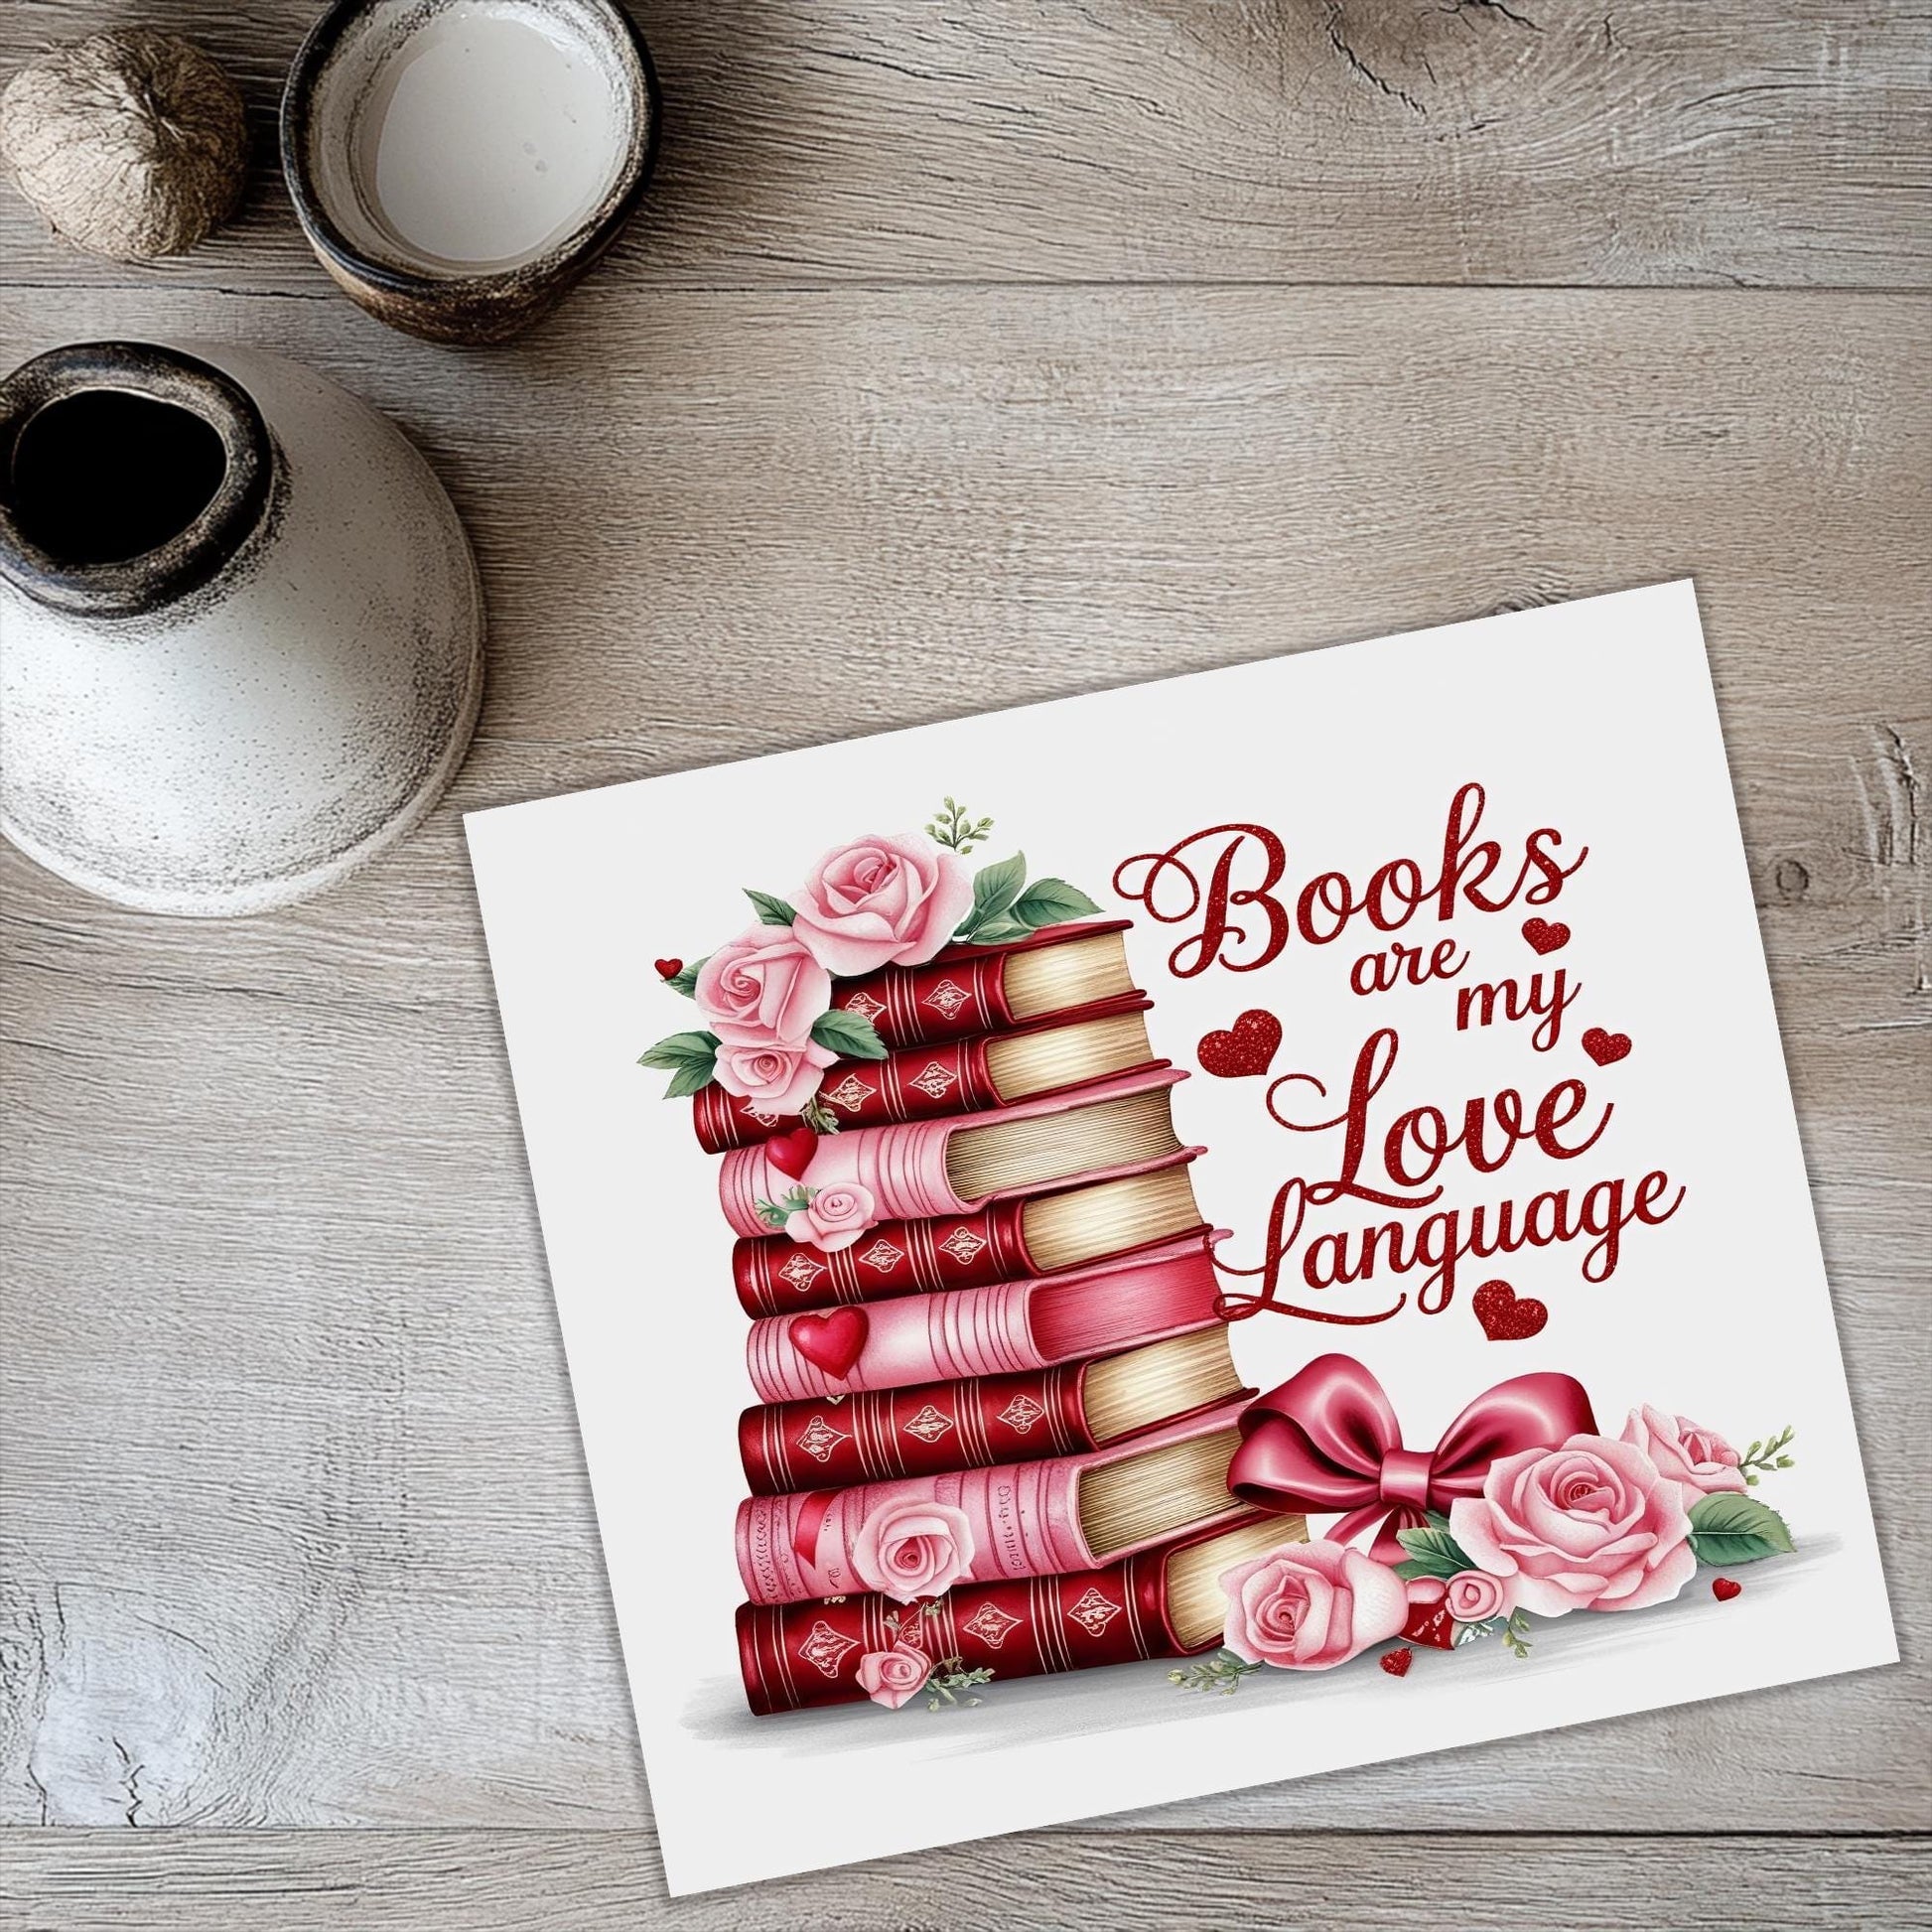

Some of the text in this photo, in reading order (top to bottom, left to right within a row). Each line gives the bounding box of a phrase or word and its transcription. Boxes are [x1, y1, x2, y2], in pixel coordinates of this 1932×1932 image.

[1112, 782, 1589, 978] Books
[1349, 938, 1470, 996] are
[1455, 968, 1583, 1052] my
[1266, 1027, 1614, 1207] Love
[1203, 1170, 1687, 1325] Language
